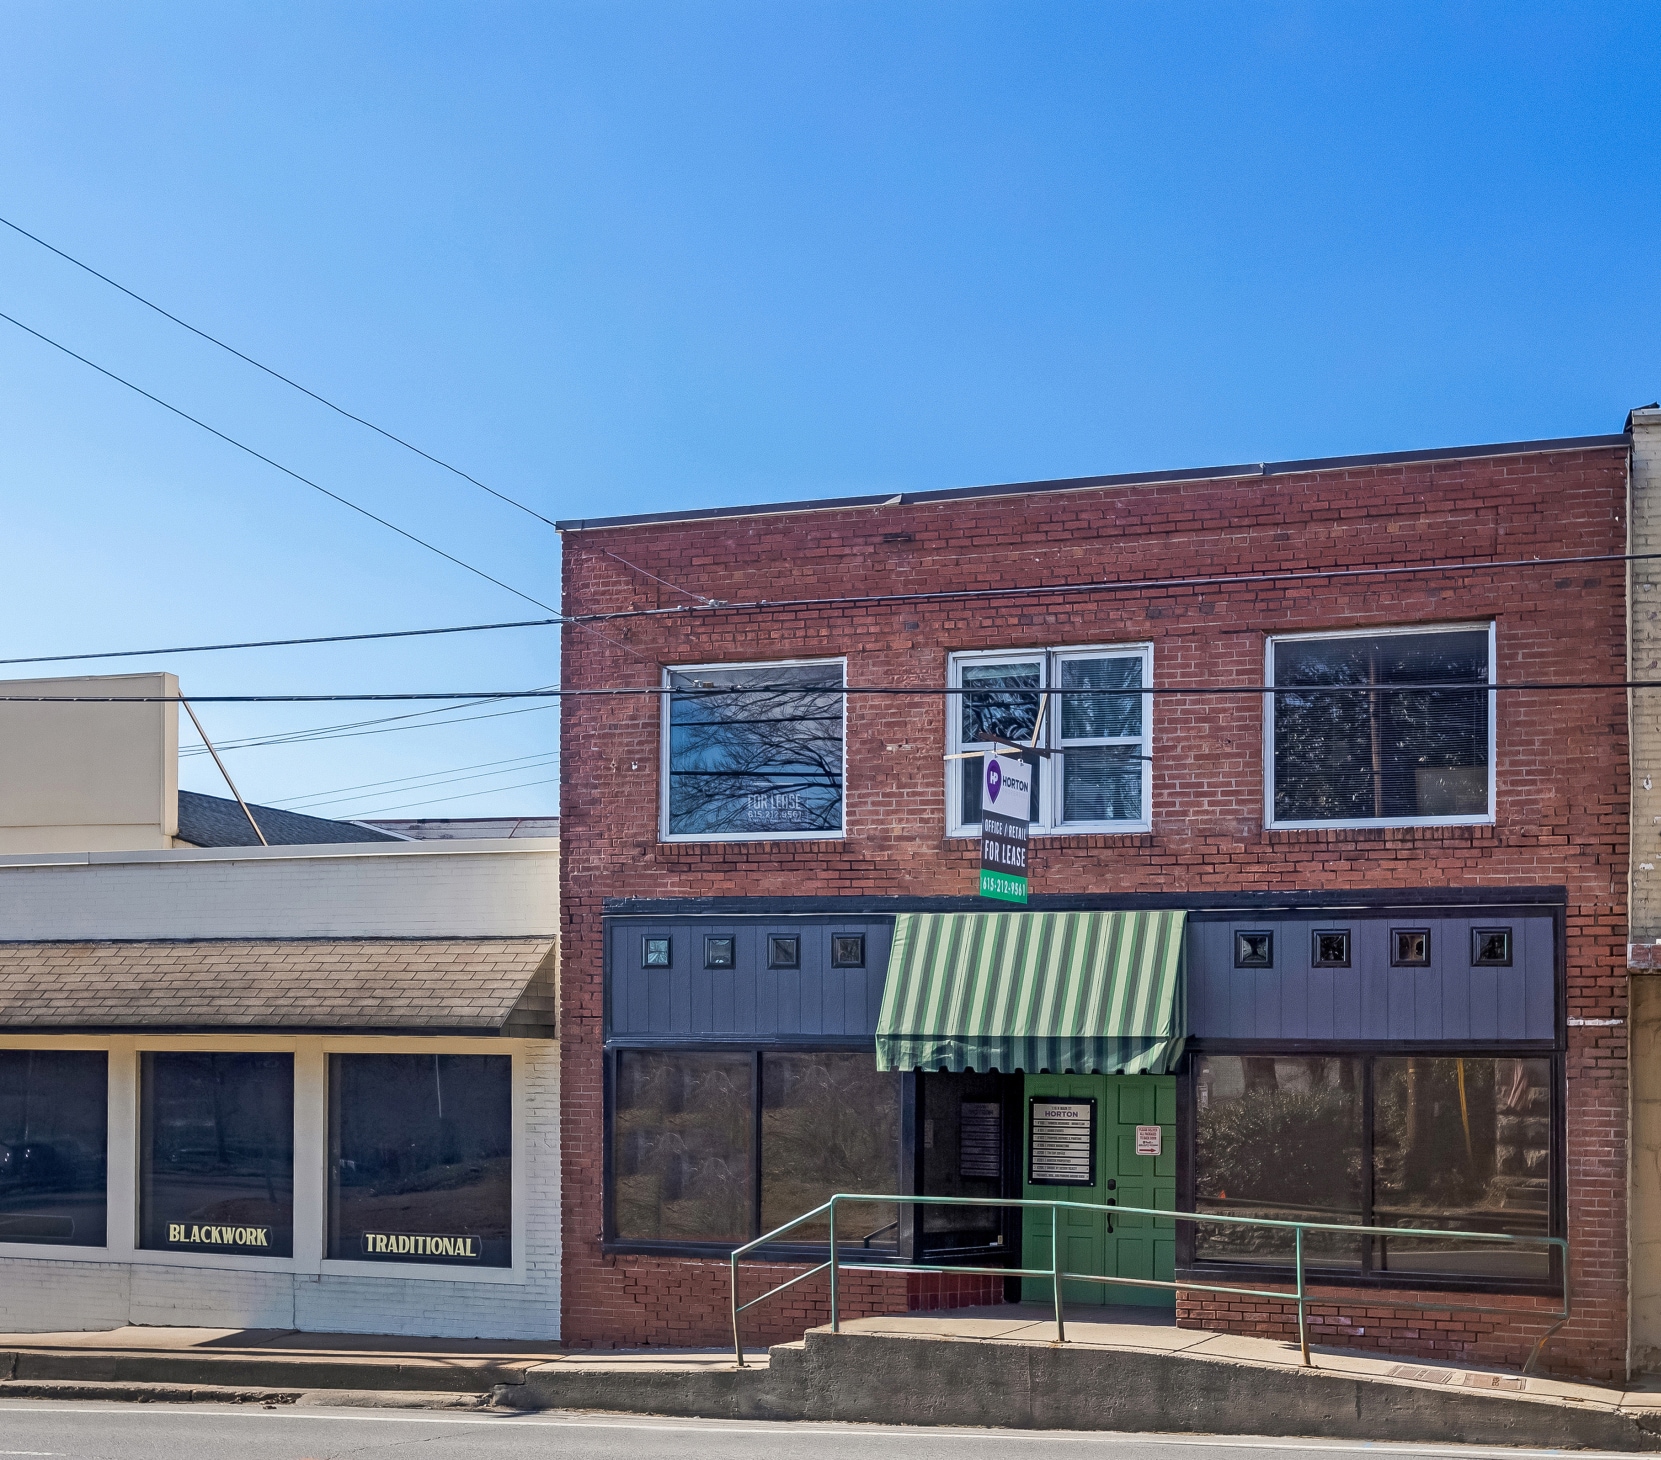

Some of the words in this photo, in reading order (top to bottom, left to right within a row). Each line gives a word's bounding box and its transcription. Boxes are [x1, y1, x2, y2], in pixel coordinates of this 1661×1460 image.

[1002, 775, 1029, 793] HORTON
[747, 793, 768, 809] FOR
[771, 793, 801, 809] LEASE
[984, 818, 1003, 835] OFFICE
[1008, 825, 1027, 841] RETAIL
[984, 840, 1000, 862] FOR
[1002, 844, 1026, 867] LEASE
[982, 877, 1026, 897] 615-212-9561
[1044, 1110, 1079, 1118] HORTON
[169, 1223, 268, 1247] BLACKWORK
[365, 1233, 477, 1257] TRADITIONAL
